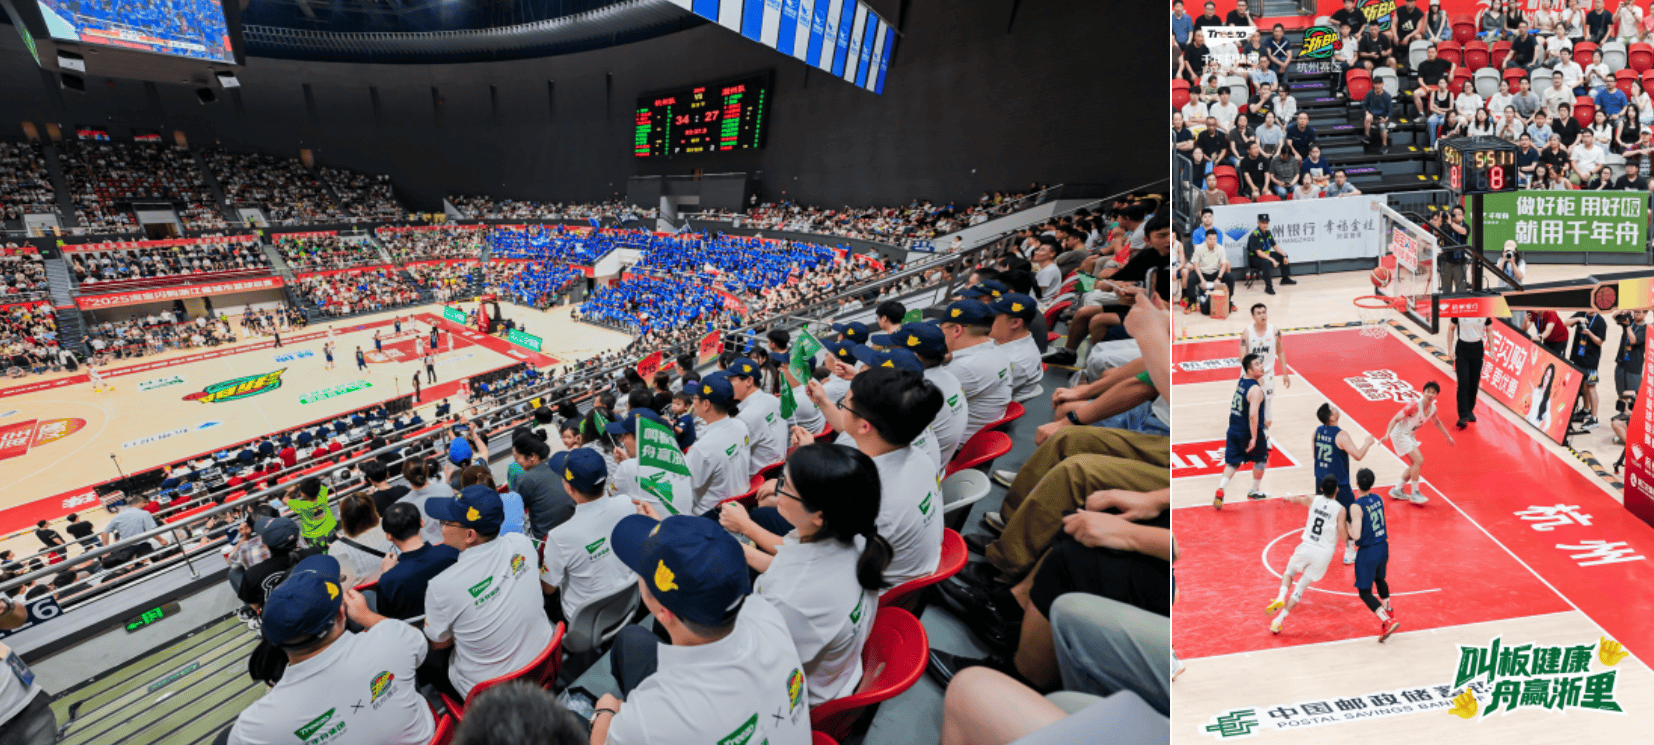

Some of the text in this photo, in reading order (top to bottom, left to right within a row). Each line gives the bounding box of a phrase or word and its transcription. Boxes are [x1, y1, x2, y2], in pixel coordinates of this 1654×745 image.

[675, 114, 690, 125] 34
[704, 110, 719, 122] 27
[1490, 166, 1504, 189] 8
[1517, 196, 1576, 216] 做好柜
[1515, 220, 1639, 246] 就用千年舟
[1315, 442, 1333, 463] 72
[1311, 517, 1325, 536] 8
[1369, 508, 1385, 532] 21
[32, 600, 59, 620] 6
[1276, 698, 1455, 728] POSTAL SAVINGS BAN
